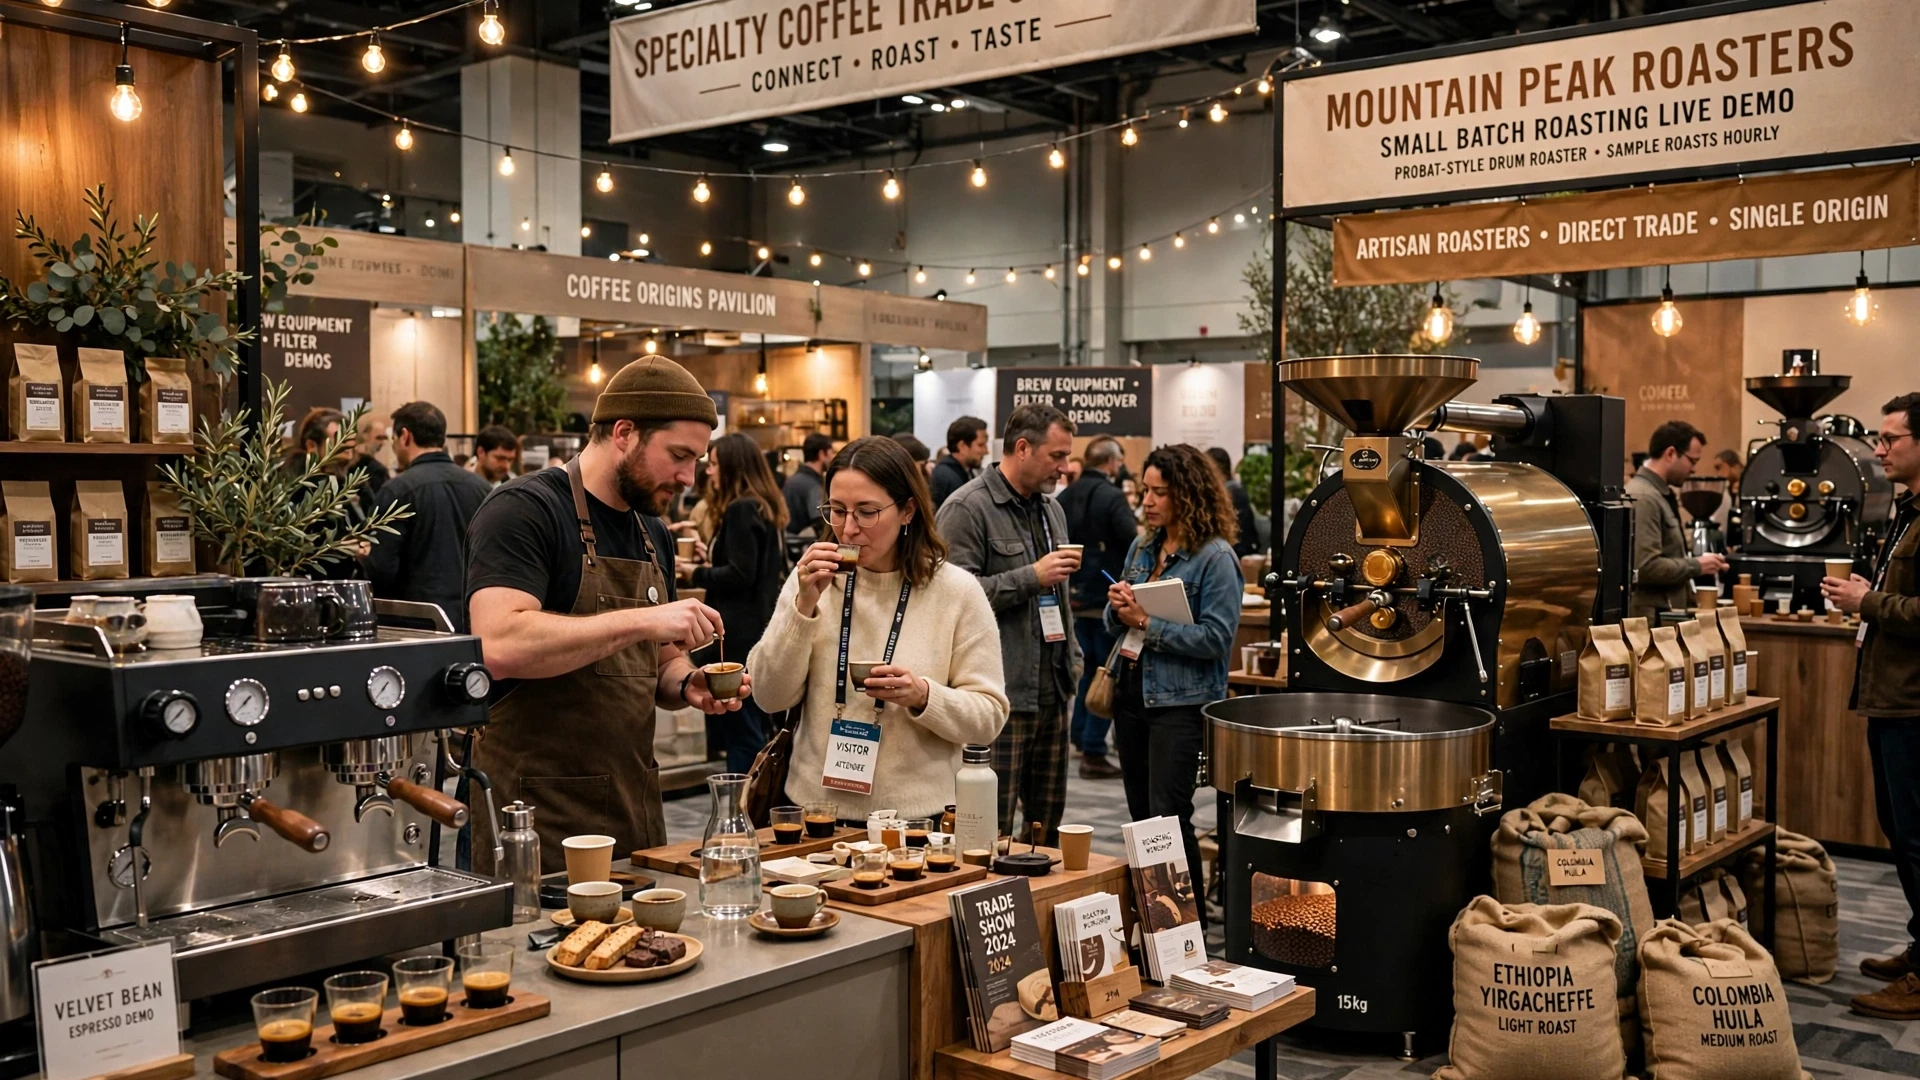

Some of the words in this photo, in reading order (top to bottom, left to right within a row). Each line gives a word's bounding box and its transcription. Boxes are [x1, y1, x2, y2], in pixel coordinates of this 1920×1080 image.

[635, 13, 768, 78] SPECIALTY
[778, 0, 882, 50] COFFEE
[752, 56, 842, 93] CONNECT
[871, 37, 939, 70] ROAST
[971, 17, 1041, 51] TASTE
[1327, 72, 1502, 131] MOUNTAIN
[1519, 56, 1616, 107] PEAK
[1633, 21, 1854, 93] ROASTERS
[1380, 130, 1447, 158] SMALL
[1457, 121, 1524, 149] BATCH
[1535, 105, 1648, 141] ROASTING
[1660, 98, 1711, 126] LIVE
[1723, 87, 1794, 119] DEMO
[1395, 158, 1484, 180] PROBAT-STYLE
[1489, 154, 1525, 170] DRUM
[1530, 147, 1587, 167] ROASTER
[1607, 138, 1660, 158] SAMPLE
[1665, 132, 1718, 151] ROASTS
[1723, 125, 1780, 146] HOURLY
[1356, 233, 1430, 260] ARTISAN
[1437, 225, 1530, 254] ROASTERS
[1558, 217, 1627, 244] DIRECT
[1633, 211, 1698, 239] TRADE
[1729, 202, 1804, 231] SINGLE
[1812, 194, 1888, 224] ORIGIN
[567, 274, 631, 302] COFFEE
[637, 281, 702, 309] ORIGINS
[708, 288, 776, 316] PAVILION
[278, 314, 353, 333] EQUIPMENT
[273, 333, 317, 350] FILTER
[285, 351, 332, 370] DEMOS
[1017, 377, 1052, 391] BREW
[1055, 377, 1125, 392] EQUIPMENT
[1072, 393, 1137, 408] POUROVER
[1068, 410, 1111, 424] DEMOS
[836, 741, 869, 756] VISITOR
[975, 892, 1015, 917] TRADE
[979, 911, 1015, 936] SHOW
[984, 931, 1016, 956] 2024
[987, 955, 1012, 975] 2024
[1494, 963, 1574, 987] ETHIOPIA
[55, 992, 114, 1021] VELVET
[121, 981, 162, 1006] BEAN
[1337, 994, 1368, 1014] 15kg
[1480, 985, 1595, 1013] YIRGACHEFFE
[1692, 982, 1775, 1006] COLOMBIA
[69, 1015, 121, 1039] ESPRESSO
[125, 1008, 154, 1025] DEMO
[1498, 1016, 1534, 1034] LIGHT
[1538, 1019, 1577, 1035] ROAST
[1712, 1008, 1764, 1029] HUILA
[1701, 1033, 1745, 1047] MEDIUM
[1749, 1030, 1778, 1047] ROAST
